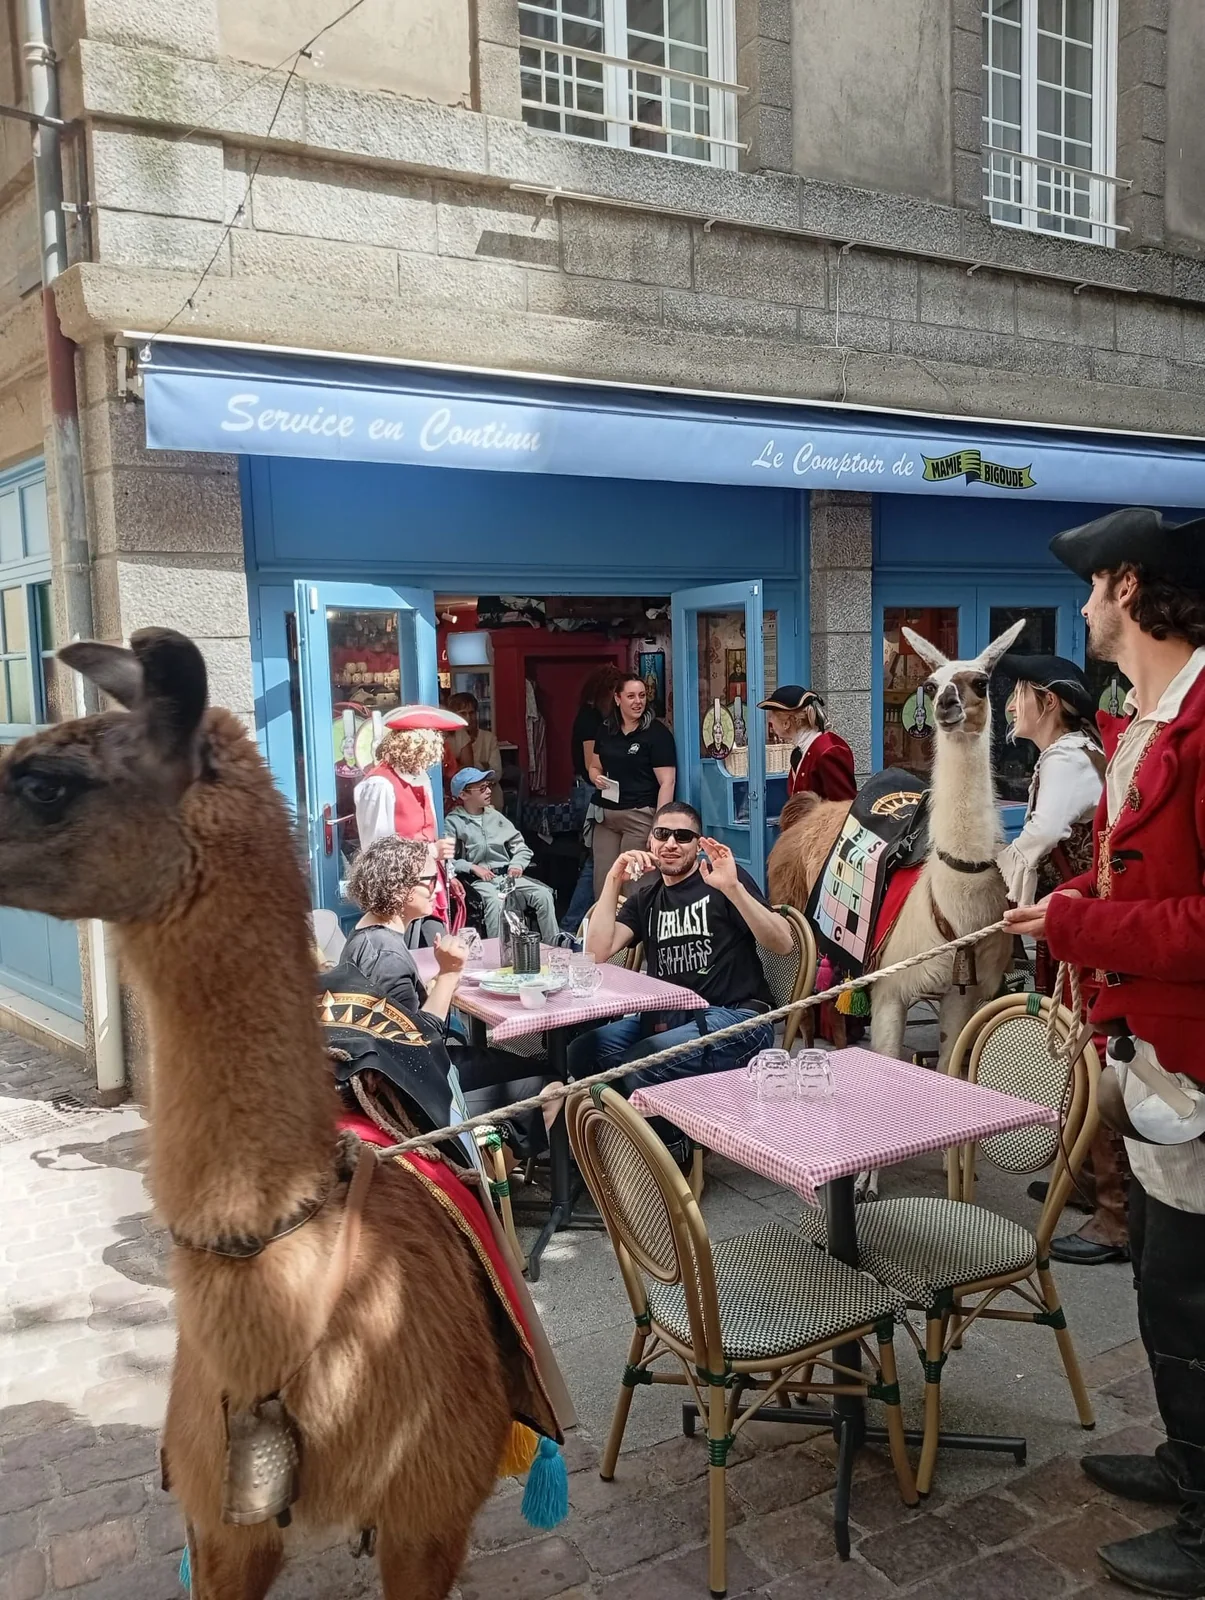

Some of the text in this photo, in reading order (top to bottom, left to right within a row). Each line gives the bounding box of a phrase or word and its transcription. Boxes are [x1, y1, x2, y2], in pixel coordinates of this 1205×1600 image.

[221, 394, 541, 451] Service en Continu
[751, 440, 1024, 488] Le Comptoir de MAMIE BIGOUDE
